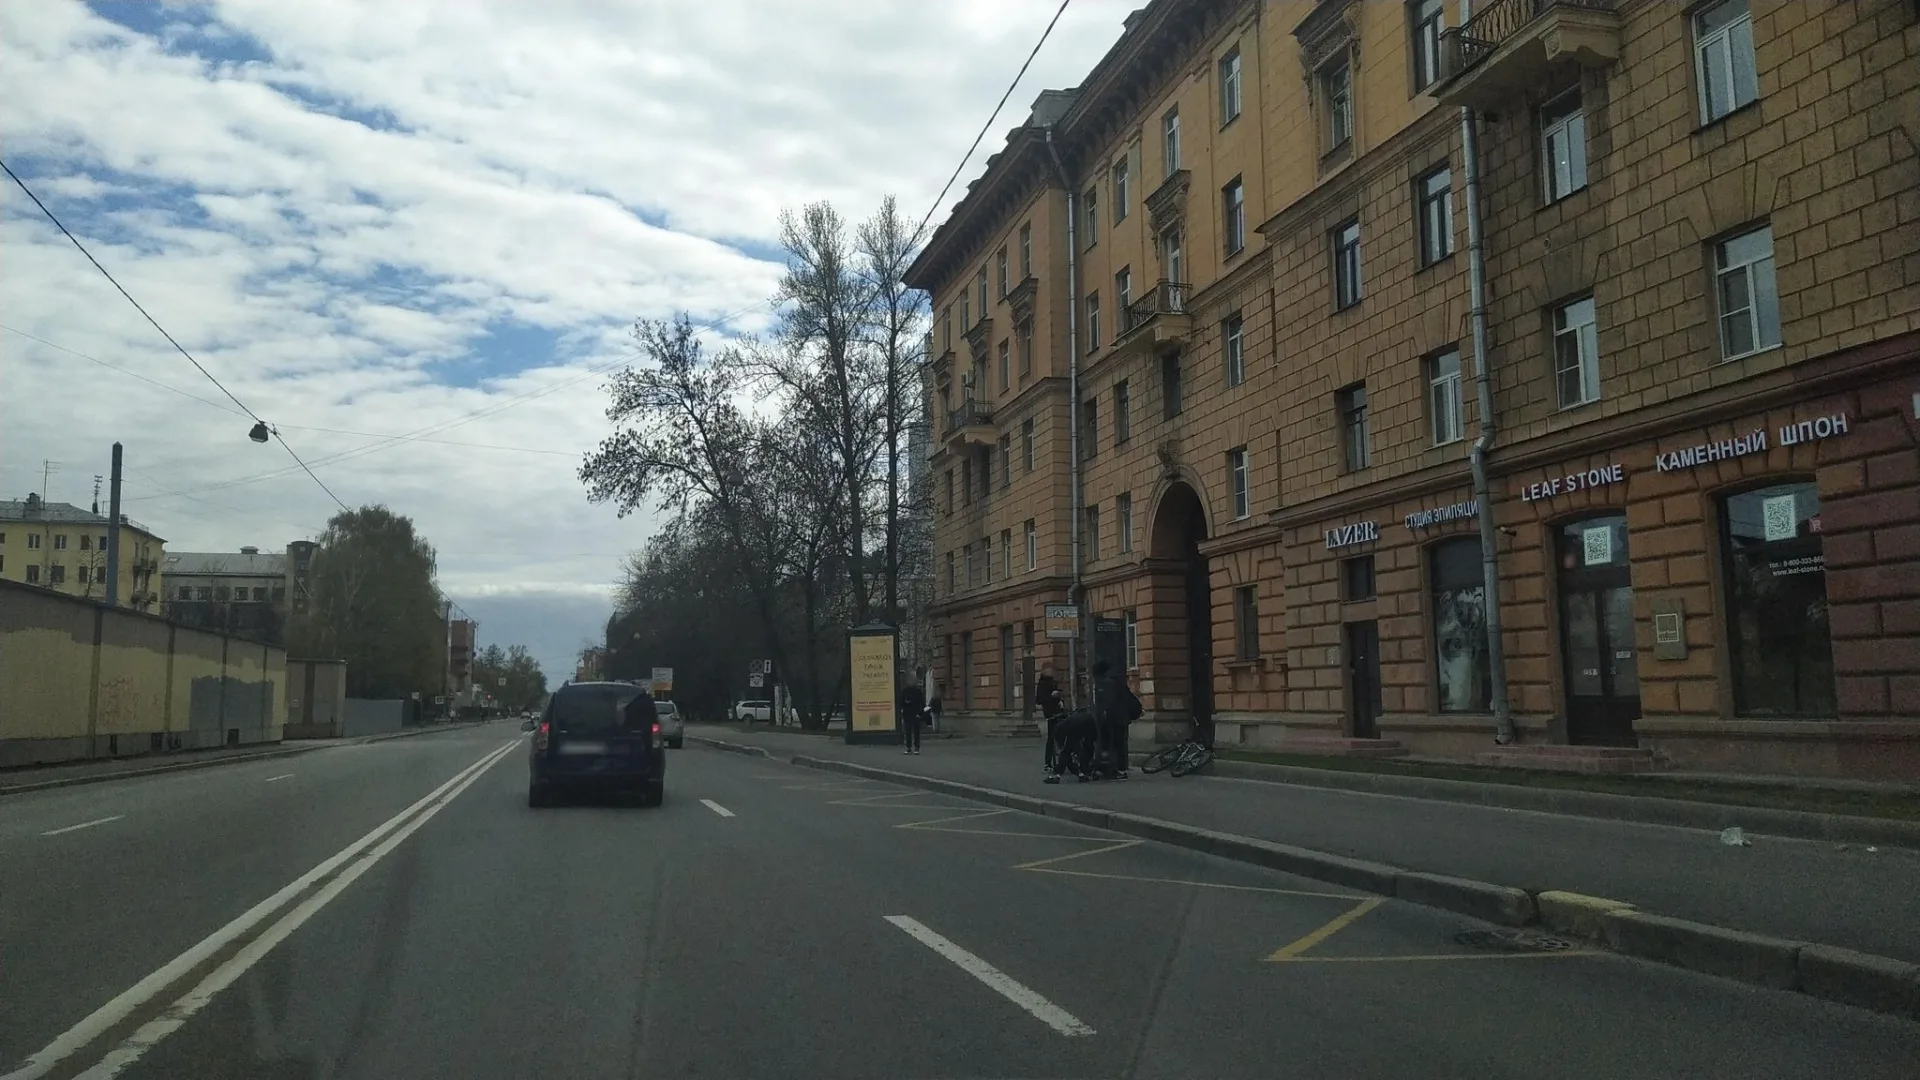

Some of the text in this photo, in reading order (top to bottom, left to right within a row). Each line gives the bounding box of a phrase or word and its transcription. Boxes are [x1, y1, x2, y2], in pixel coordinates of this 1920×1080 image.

[1656, 412, 1848, 472] КАМЕННЫЙ ШПОН
[1521, 464, 1623, 501] LEAF STONE
[1404, 500, 1478, 528] СТУДИЯ ЭПИЛЯЦИ
